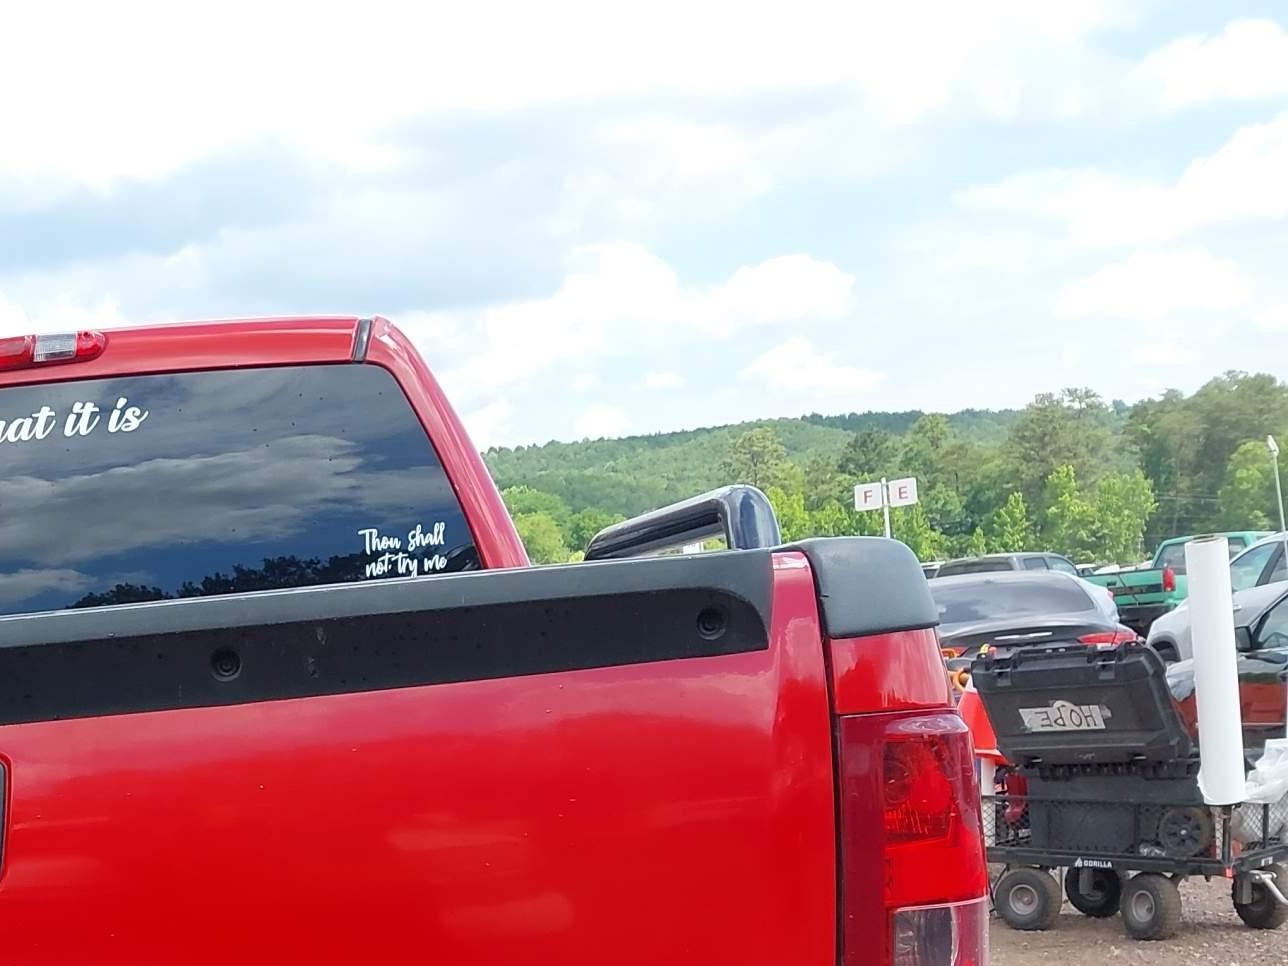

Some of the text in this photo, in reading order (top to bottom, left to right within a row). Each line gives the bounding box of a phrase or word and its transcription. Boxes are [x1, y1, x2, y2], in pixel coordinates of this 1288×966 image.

[64, 401, 100, 437] it
[107, 397, 149, 433] is
[863, 489, 873, 504] F
[898, 486, 909, 500] E
[357, 522, 446, 555] Thou shall
[392, 551, 418, 578] try
[423, 554, 448, 572] me
[1034, 704, 1097, 728] HOPE
[1083, 859, 1113, 868] GORILLA
